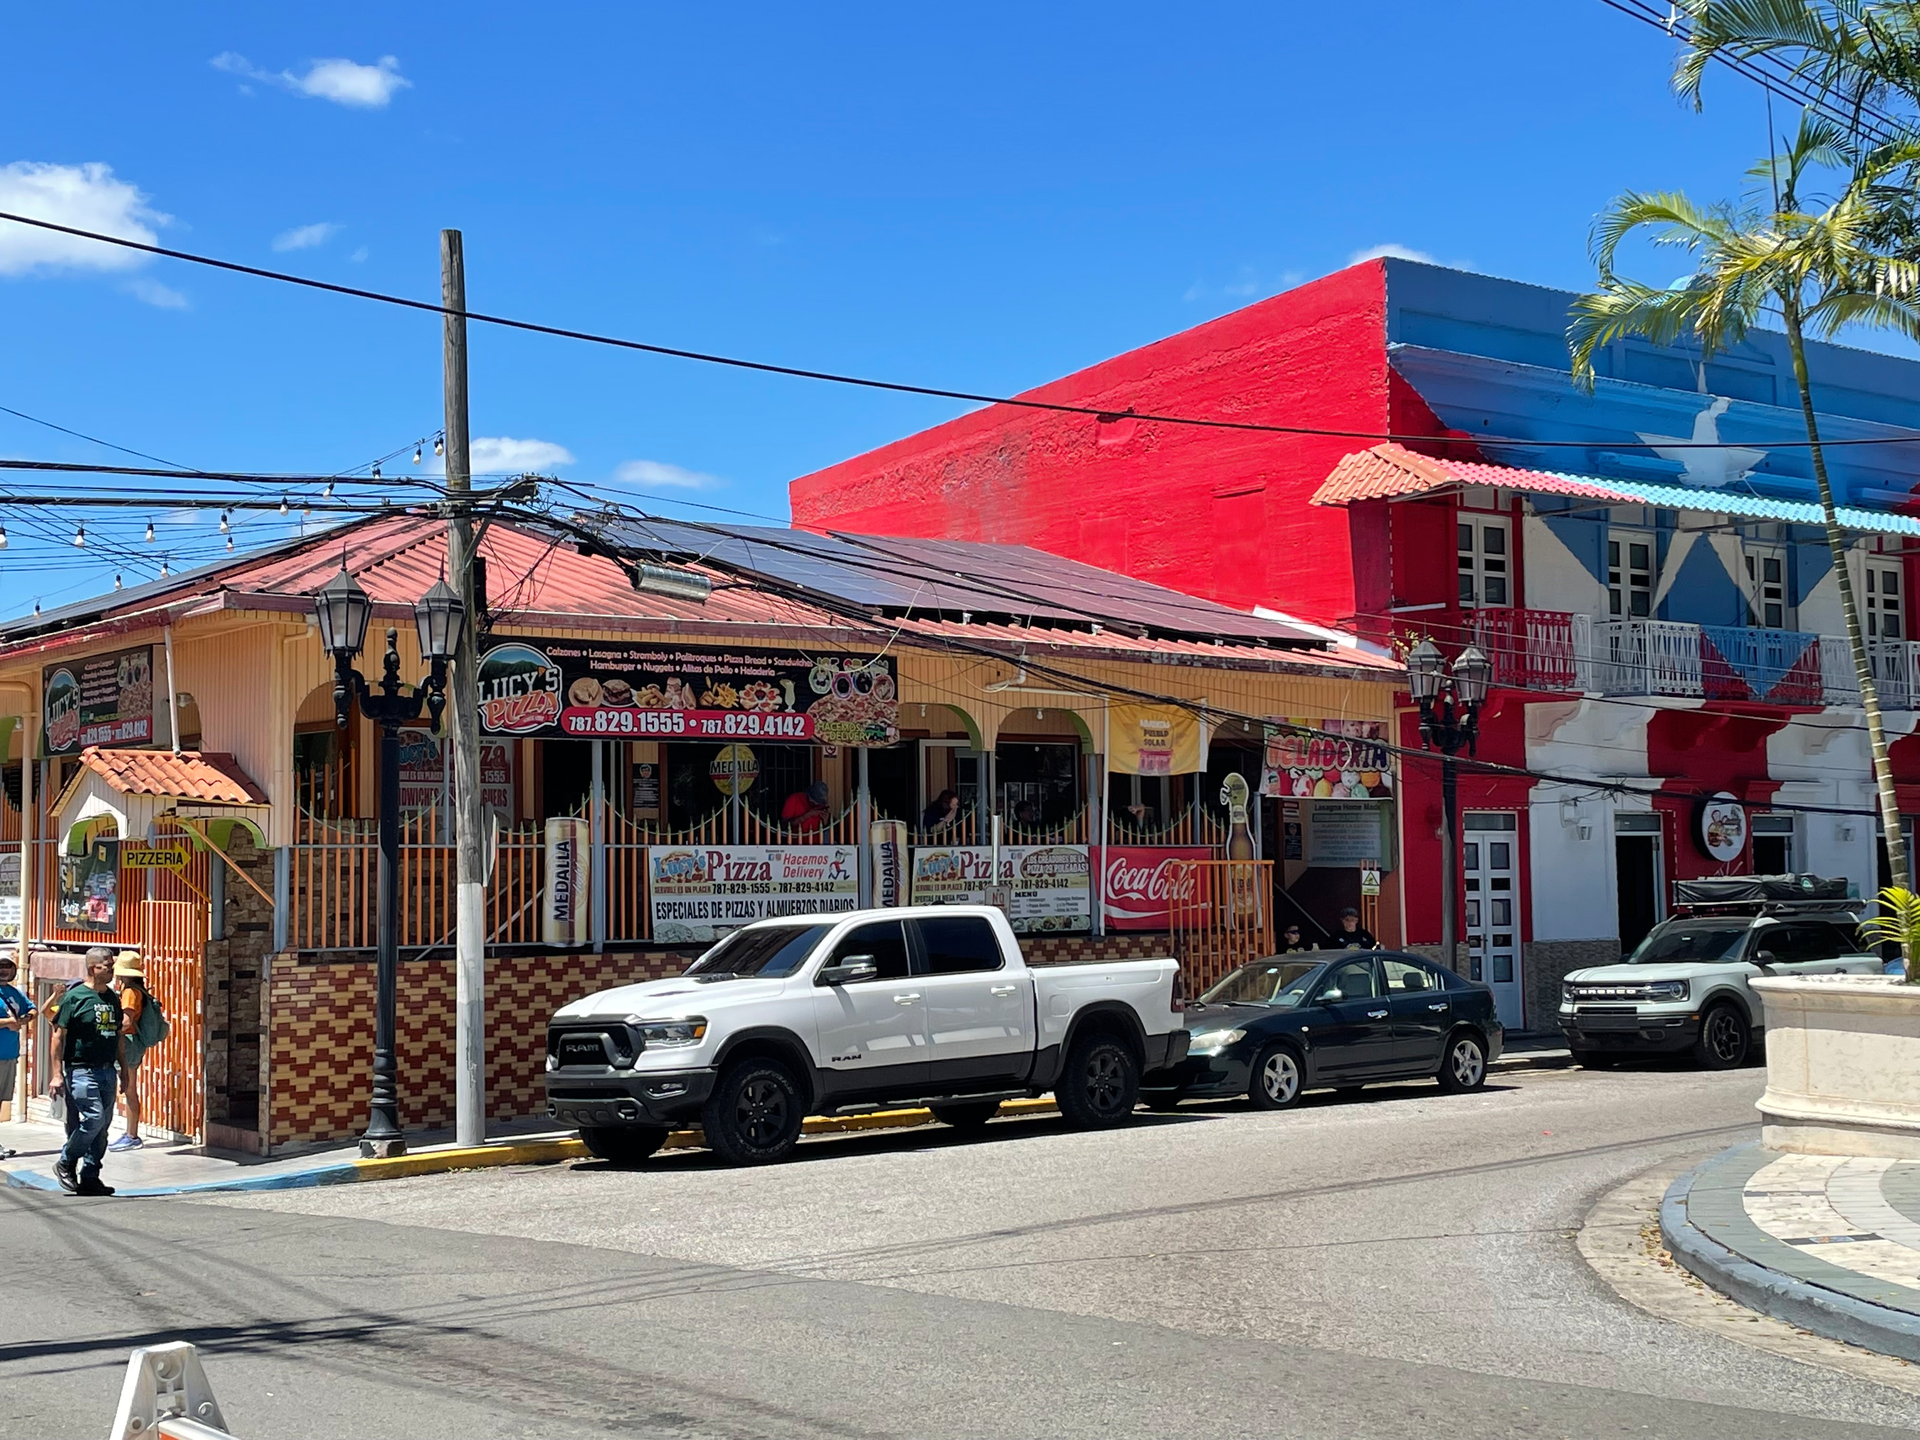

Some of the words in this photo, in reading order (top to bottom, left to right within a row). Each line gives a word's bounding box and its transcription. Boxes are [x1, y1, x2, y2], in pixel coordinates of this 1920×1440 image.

[546, 646, 581, 657] Calzones
[588, 648, 622, 660] Lasagna
[629, 650, 668, 662] Stromboly
[675, 652, 717, 664] Palitroques
[723, 654, 743, 664] Pizza
[744, 655, 767, 665] Bread
[773, 657, 813, 667] Sandwiches
[590, 660, 636, 672] Hamburger
[642, 662, 674, 673] Nuggets
[681, 663, 702, 674] Alitas
[703, 664, 714, 673] de
[714, 664, 733, 675] Pollo
[478, 667, 559, 703] LUCY'S
[569, 710, 685, 734] 787.829.1555
[701, 713, 805, 736] 787.829.4142
[1143, 738, 1166, 747] SOLAR
[400, 735, 437, 770] ucy's
[127, 851, 184, 866] PIZZERIA
[654, 848, 707, 880] Lucy's
[705, 850, 773, 882] Pizza
[783, 852, 829, 866] Hacemos
[917, 849, 960, 877] Lucy's
[959, 850, 1015, 880] Piza
[553, 840, 571, 922] MEDALLA
[783, 866, 825, 880] Delivery
[712, 882, 771, 895] 787-829-1555
[778, 881, 835, 894] 787-829-4142
[1020, 878, 1069, 890] 787-829-4142
[655, 901, 709, 920] ESPECIALES
[711, 901, 723, 919] DE
[725, 900, 755, 919] PIZZAS
[757, 900, 764, 918] Y
[766, 899, 818, 917] ALMUERZOS
[820, 898, 855, 912] DIARIOS
[565, 1043, 600, 1052] RAM
[831, 1053, 862, 1063] RAM
